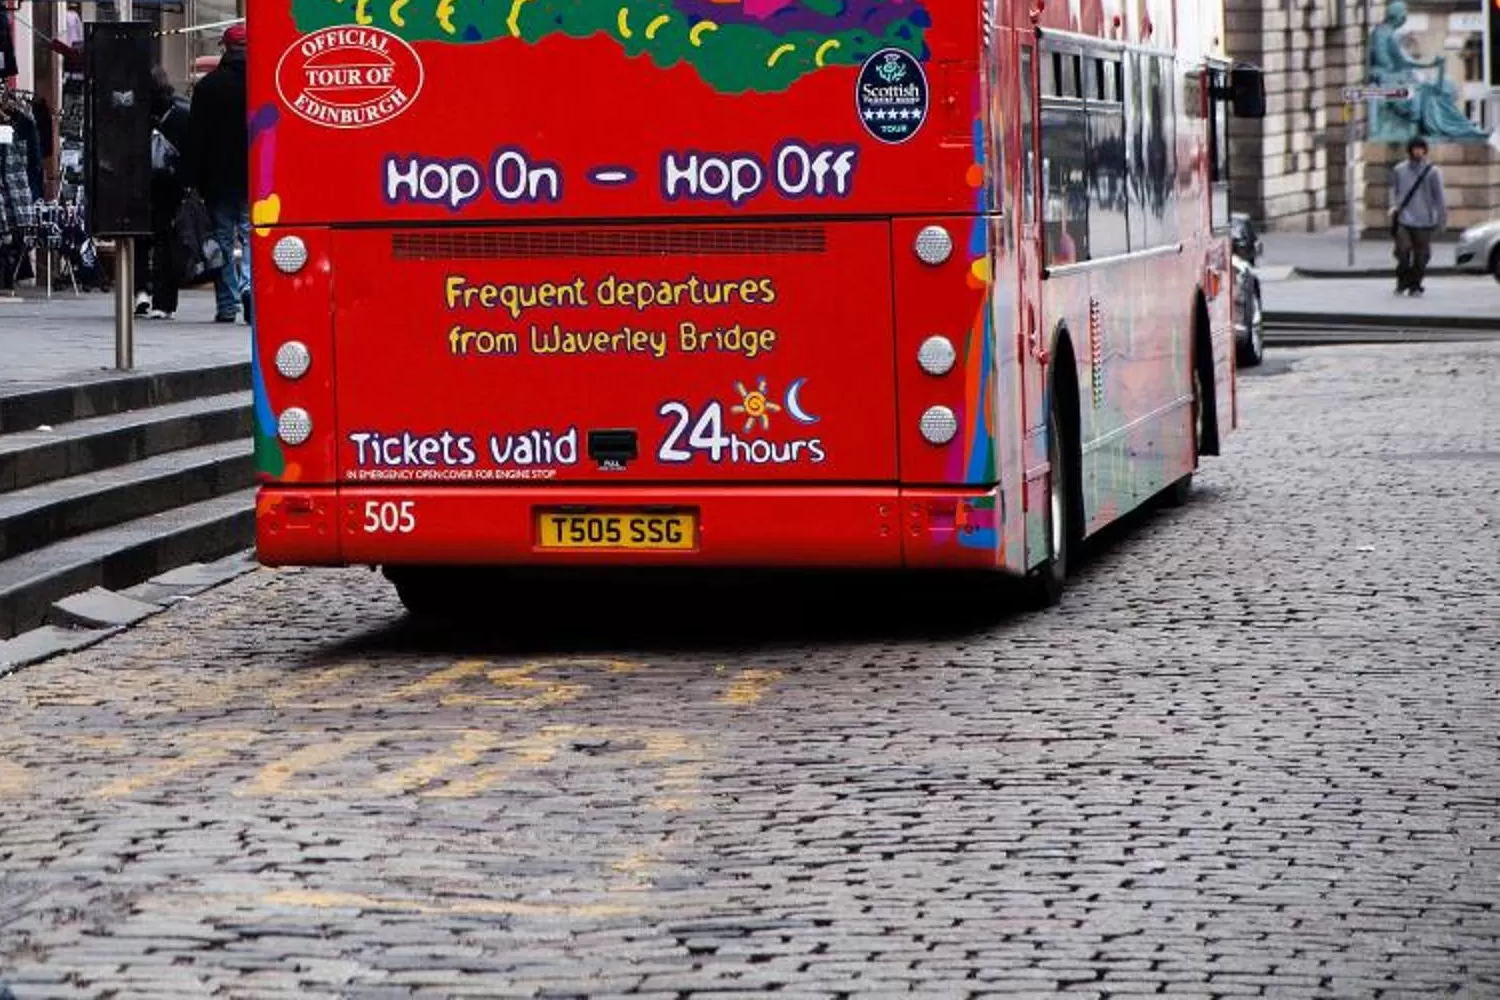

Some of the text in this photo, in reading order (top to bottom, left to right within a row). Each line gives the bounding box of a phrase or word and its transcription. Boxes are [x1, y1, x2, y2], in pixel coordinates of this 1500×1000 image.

[301, 30, 390, 56] OFFICIAL
[305, 67, 394, 86] TOUR OF
[863, 83, 919, 97] Scottish
[293, 88, 408, 123] EDINBURGH
[387, 158, 479, 206] Hop
[495, 151, 557, 198] On
[666, 155, 761, 201] Hop
[777, 145, 855, 194] Off
[446, 275, 775, 318] Frequent departures
[449, 322, 776, 357] from Waverley Bridge
[350, 430, 475, 466] Tickets
[490, 428, 578, 465] valid
[346, 470, 556, 480] IN EMERGENCY OPEN COVER FOR ENGINE STOP
[364, 501, 415, 533] 505
[552, 518, 683, 543] T505 SSG
